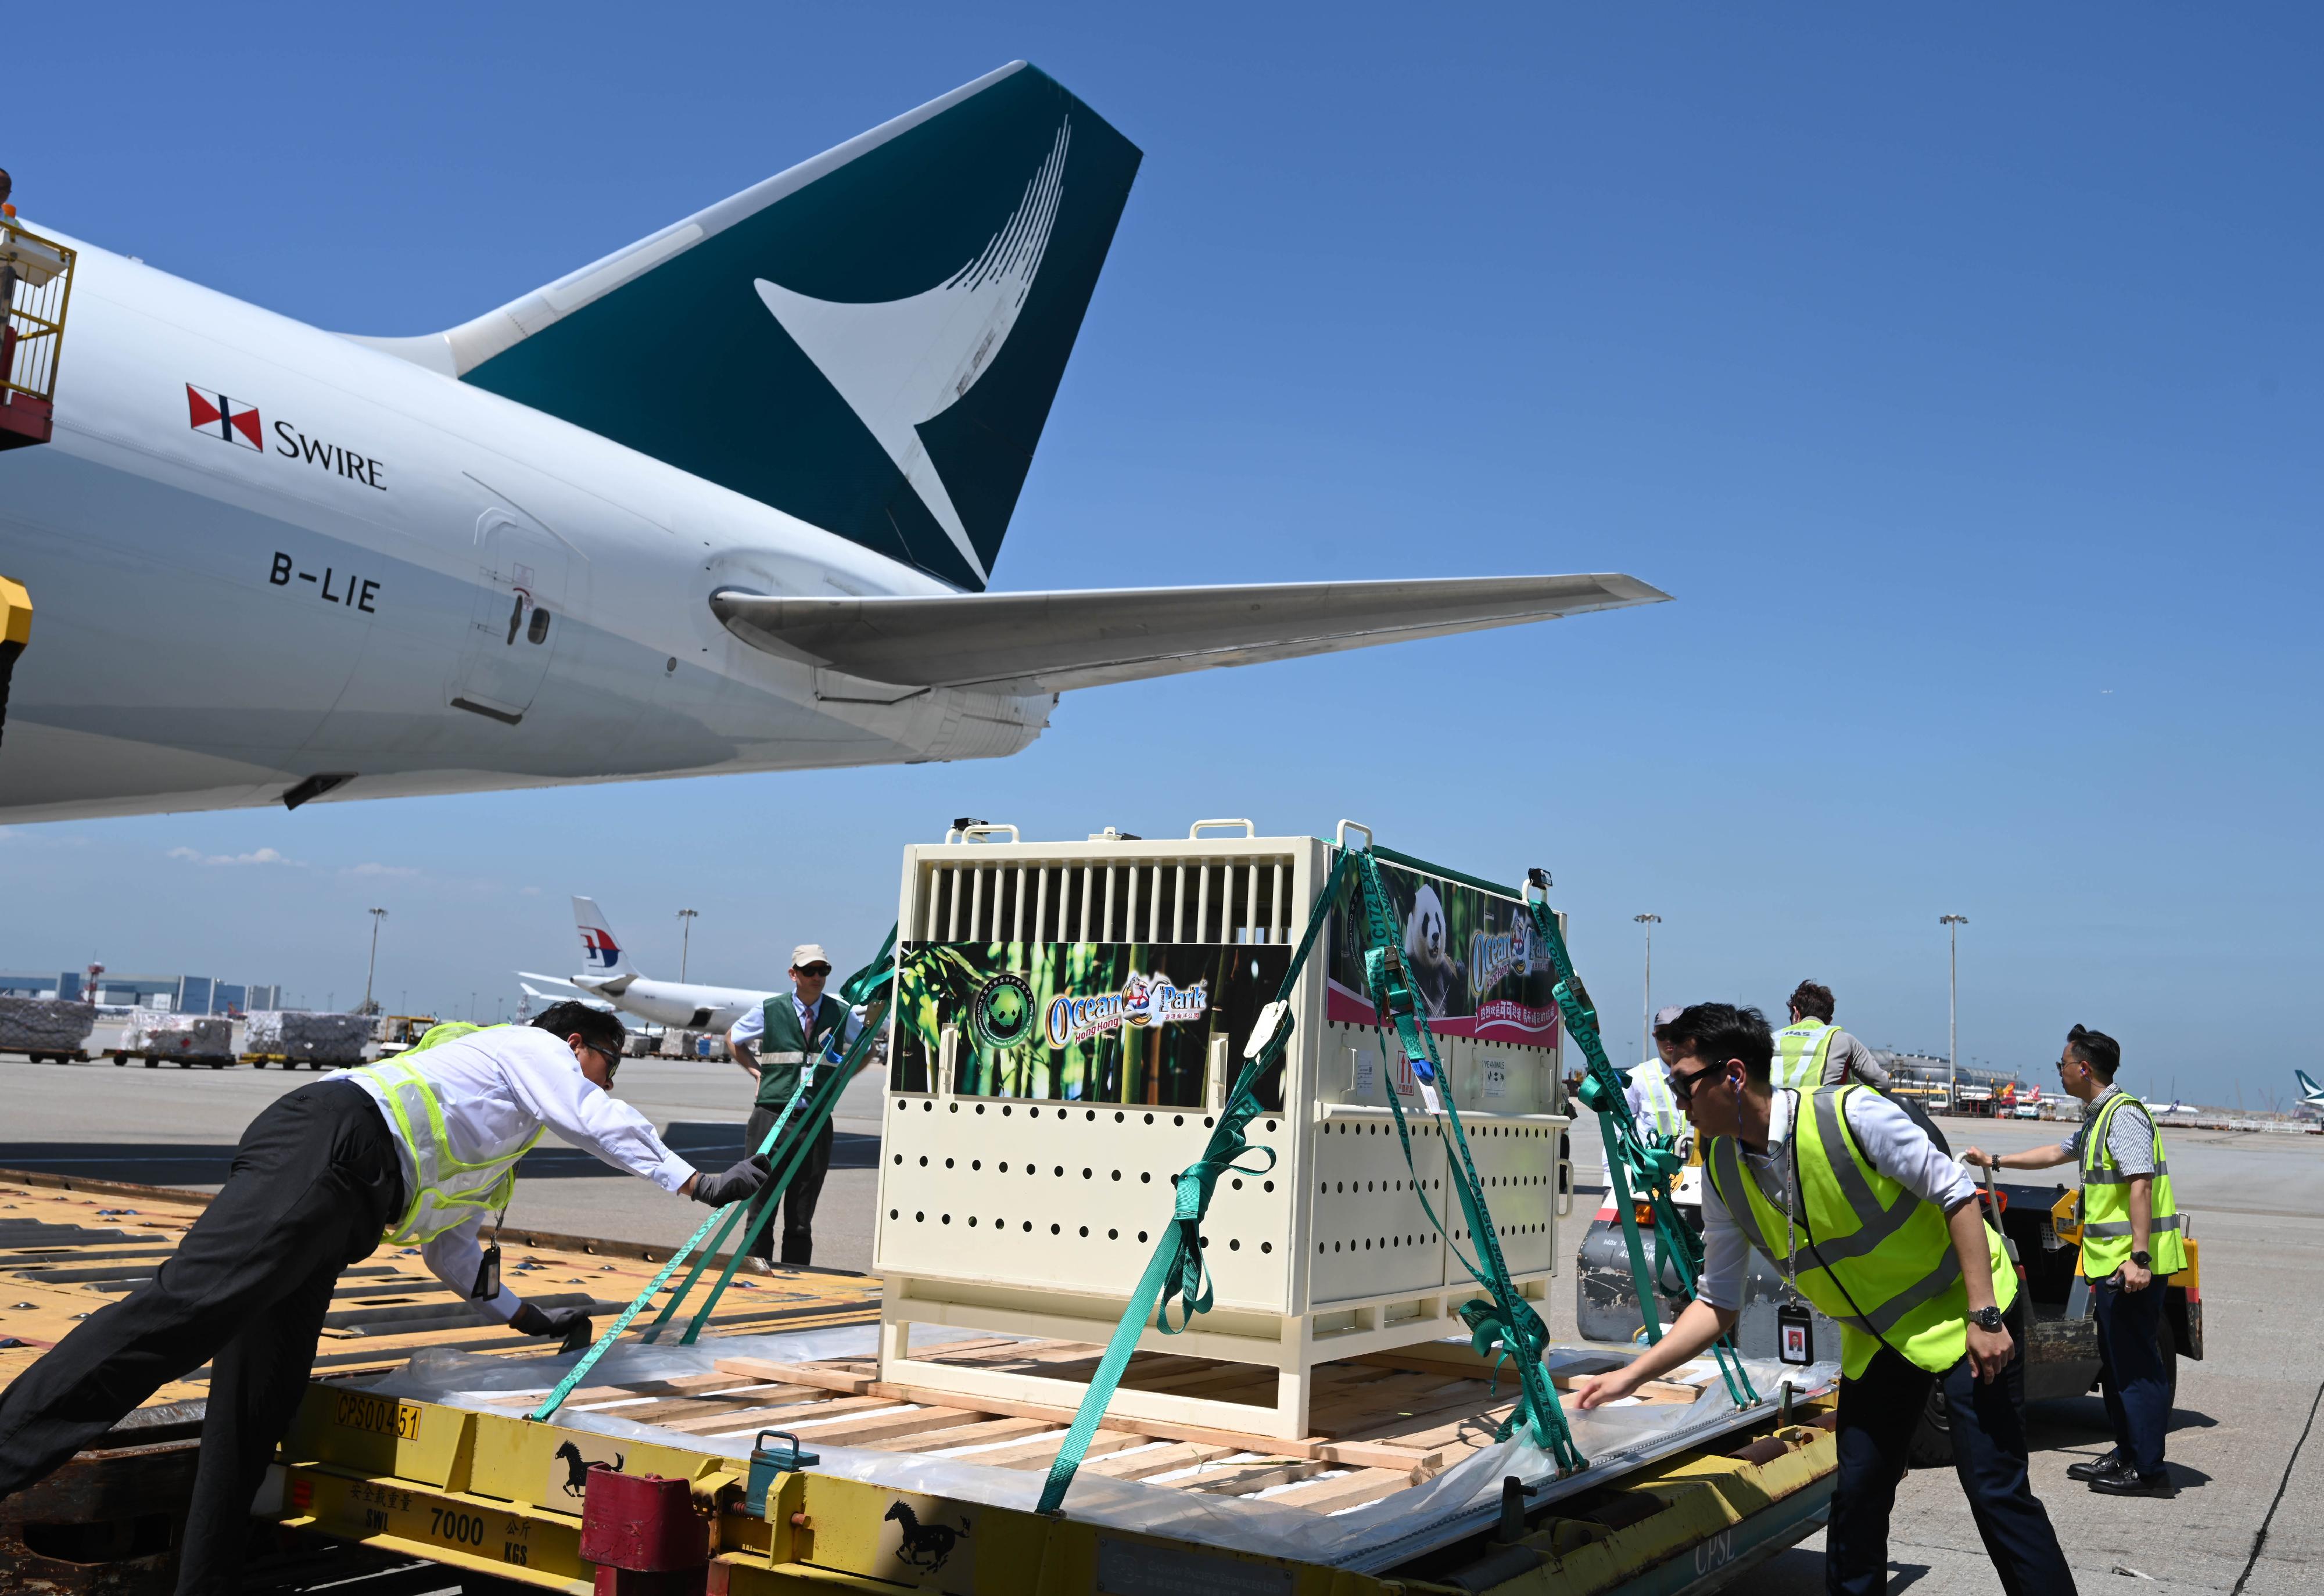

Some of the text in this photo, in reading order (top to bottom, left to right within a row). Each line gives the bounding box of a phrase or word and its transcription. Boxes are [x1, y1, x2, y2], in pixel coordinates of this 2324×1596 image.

[270, 551, 381, 614] B-LIE
[1357, 860, 1375, 896] EXP
[1365, 899, 1387, 940] C172
[1470, 930, 1510, 996] Ocean
[1487, 964, 1509, 992] Hong Kong
[977, 1014, 988, 1037] Conservation
[1046, 986, 1206, 1048] Ocean Park
[1075, 1018, 1119, 1045] Hong Kong
[1403, 964, 1421, 1002] C172
[1417, 1007, 1433, 1041] EXP
[1426, 1042, 1455, 1103] 09/2027
[1556, 994, 1588, 1031] C172
[1490, 1061, 1505, 1069] ANIMALS
[1576, 1028, 1605, 1061] TSO
[1595, 1058, 1630, 1113] 2268KG
[648, 1238, 699, 1290] 5000LB
[1459, 1142, 1473, 1167] CX
[1468, 1171, 1497, 1238] CARGO
[1491, 1243, 1519, 1307] 5000LB
[1516, 1322, 1546, 1392] 2268KG
[590, 1296, 645, 1358] 2268KG
[338, 1396, 417, 1439] CPS00451
[365, 1508, 527, 1566] SWL 7000 KGS
[505, 1519, 531, 1540] 公斤
